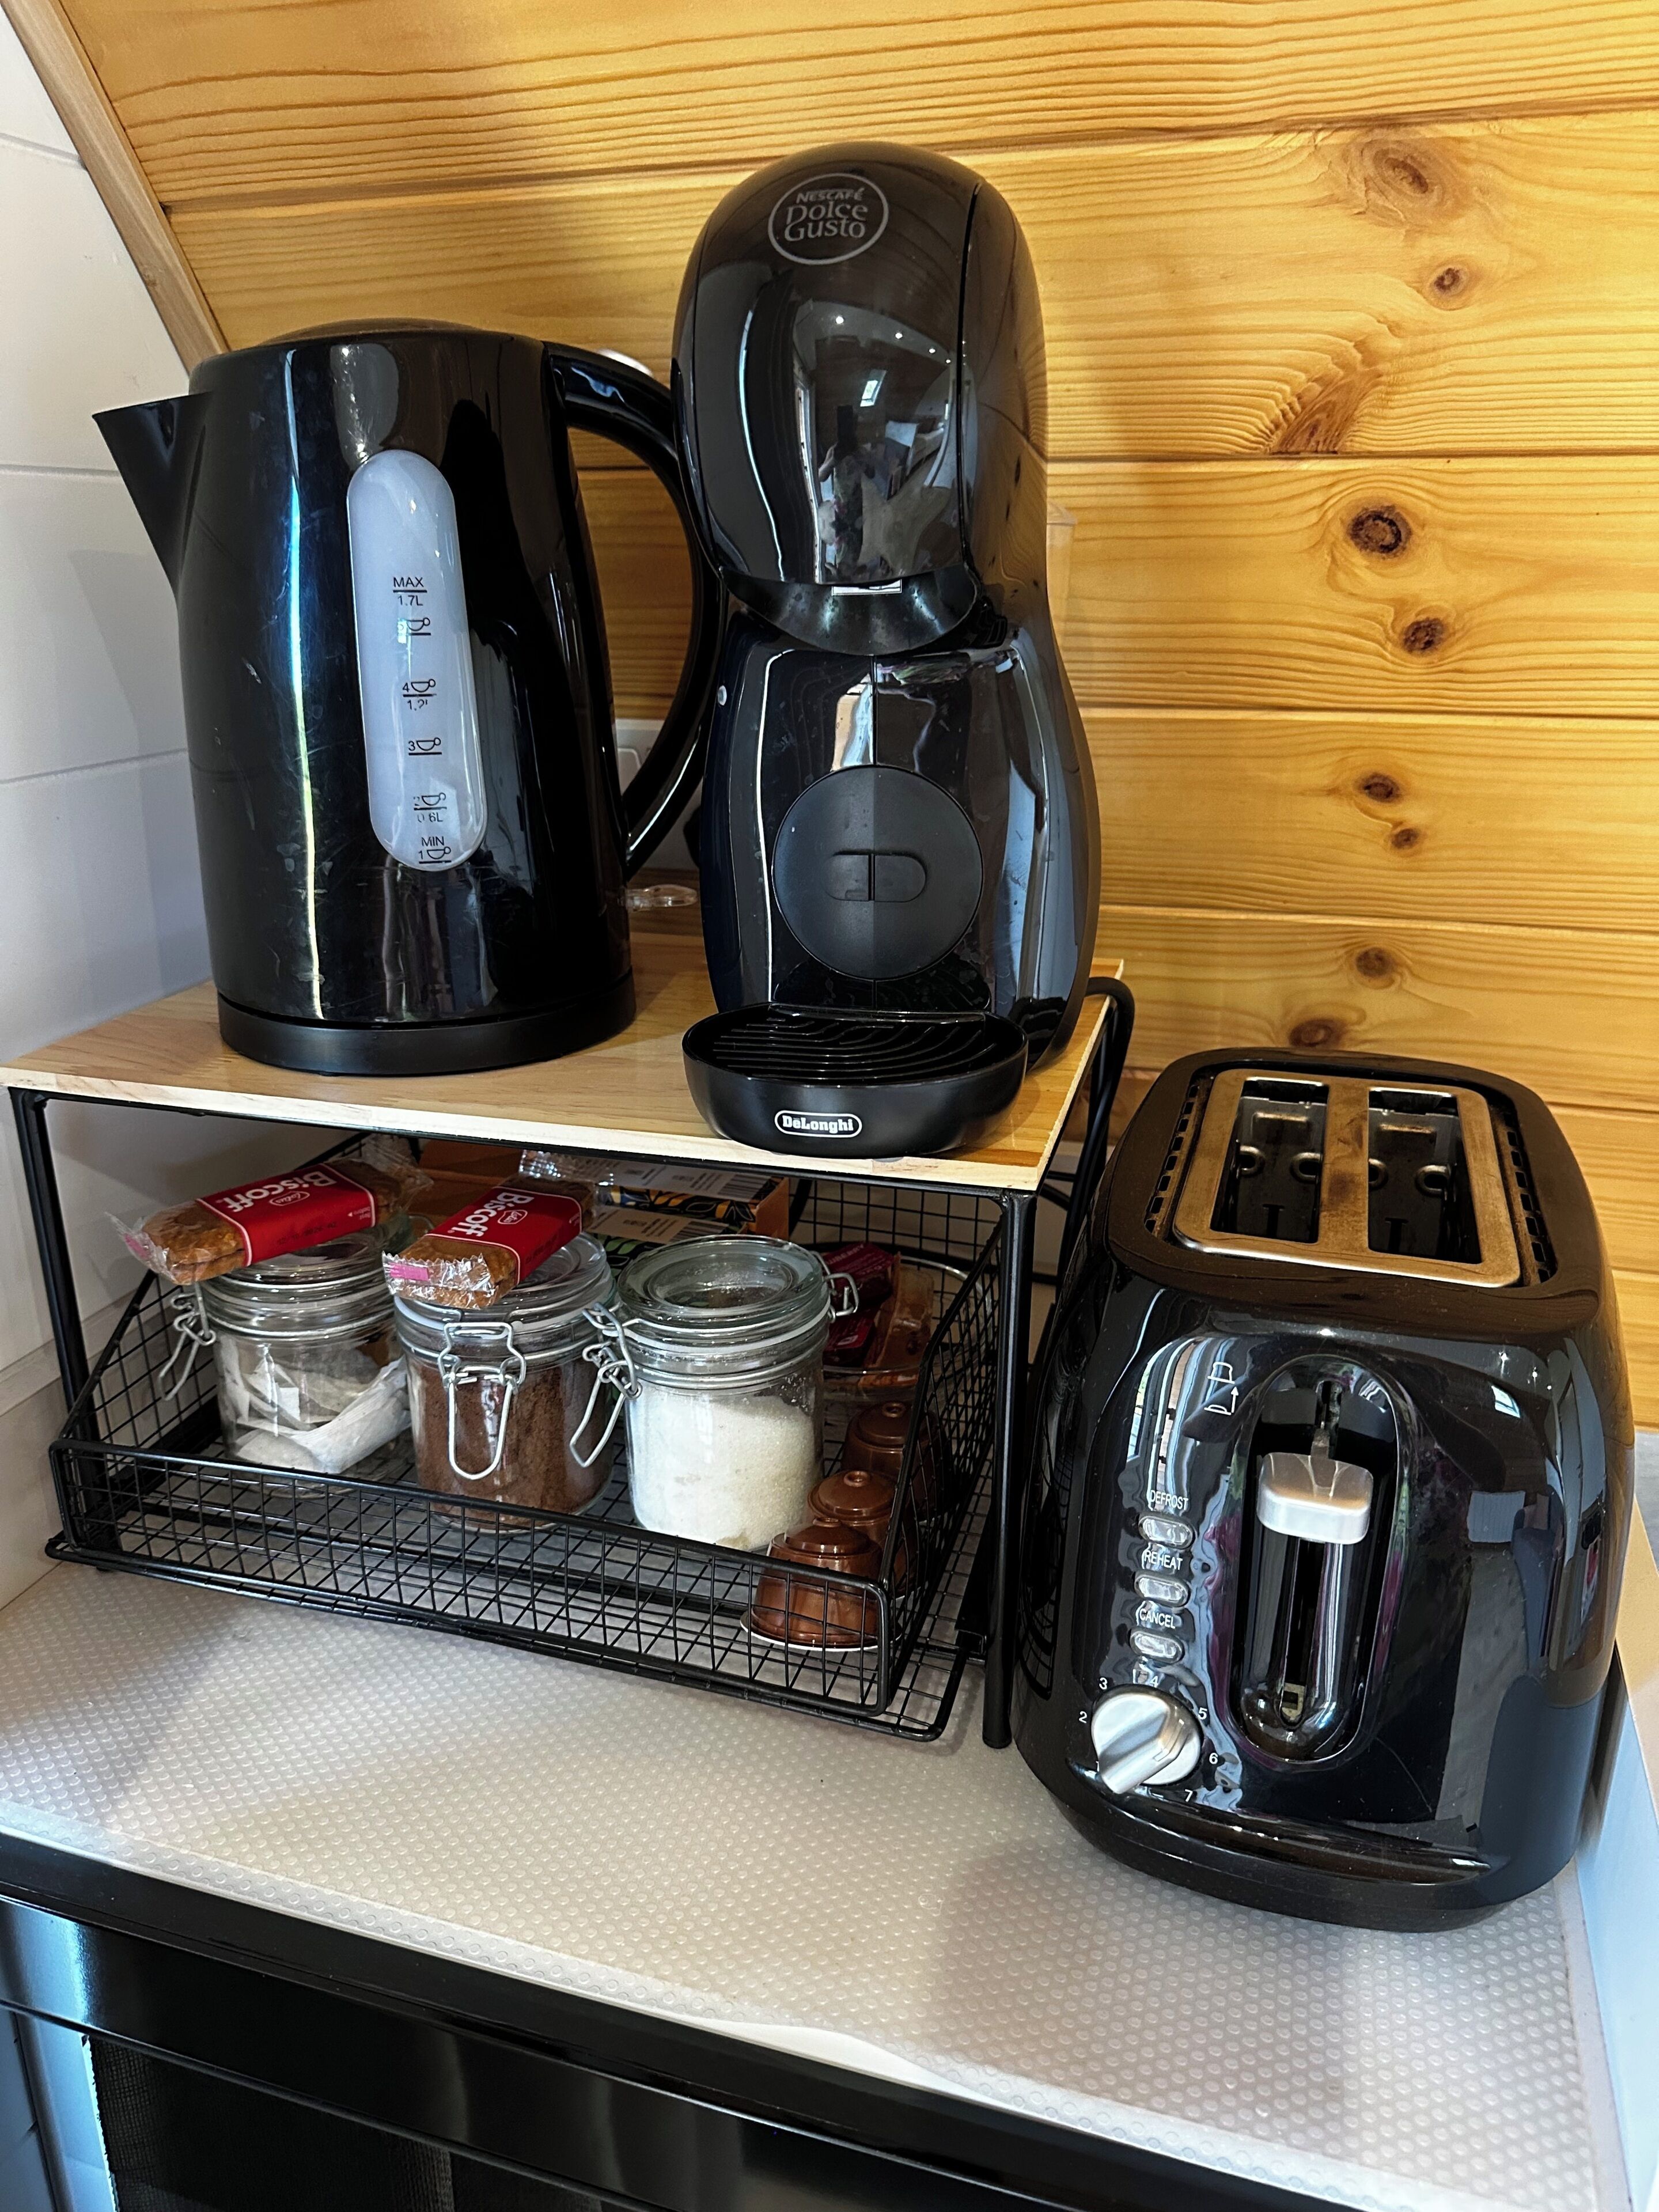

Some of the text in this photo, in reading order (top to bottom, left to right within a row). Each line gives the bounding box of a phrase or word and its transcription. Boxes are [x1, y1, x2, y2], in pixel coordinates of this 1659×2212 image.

[796, 188, 865, 203] NESCAFÉ
[786, 202, 868, 225] Dolce
[784, 217, 865, 241] Gusto
[393, 577, 424, 588] MAX
[397, 596, 423, 606] 1.7L
[403, 683, 410, 692] 4
[408, 741, 415, 751] 3
[422, 836, 445, 846] MIN
[418, 851, 423, 859] 1
[223, 1171, 337, 1213] Biscoff
[451, 1192, 535, 1237] Biscoff
[1150, 1490, 1188, 1510] DEFROST
[1145, 1551, 1183, 1570] REHEAT
[1139, 1608, 1176, 1628] CANCEL
[1099, 1677, 1108, 1690] 3
[1078, 1711, 1087, 1723] 2
[1198, 1707, 1207, 1719] 5
[1209, 1752, 1218, 1764] 6
[1185, 1789, 1194, 1802] 7
